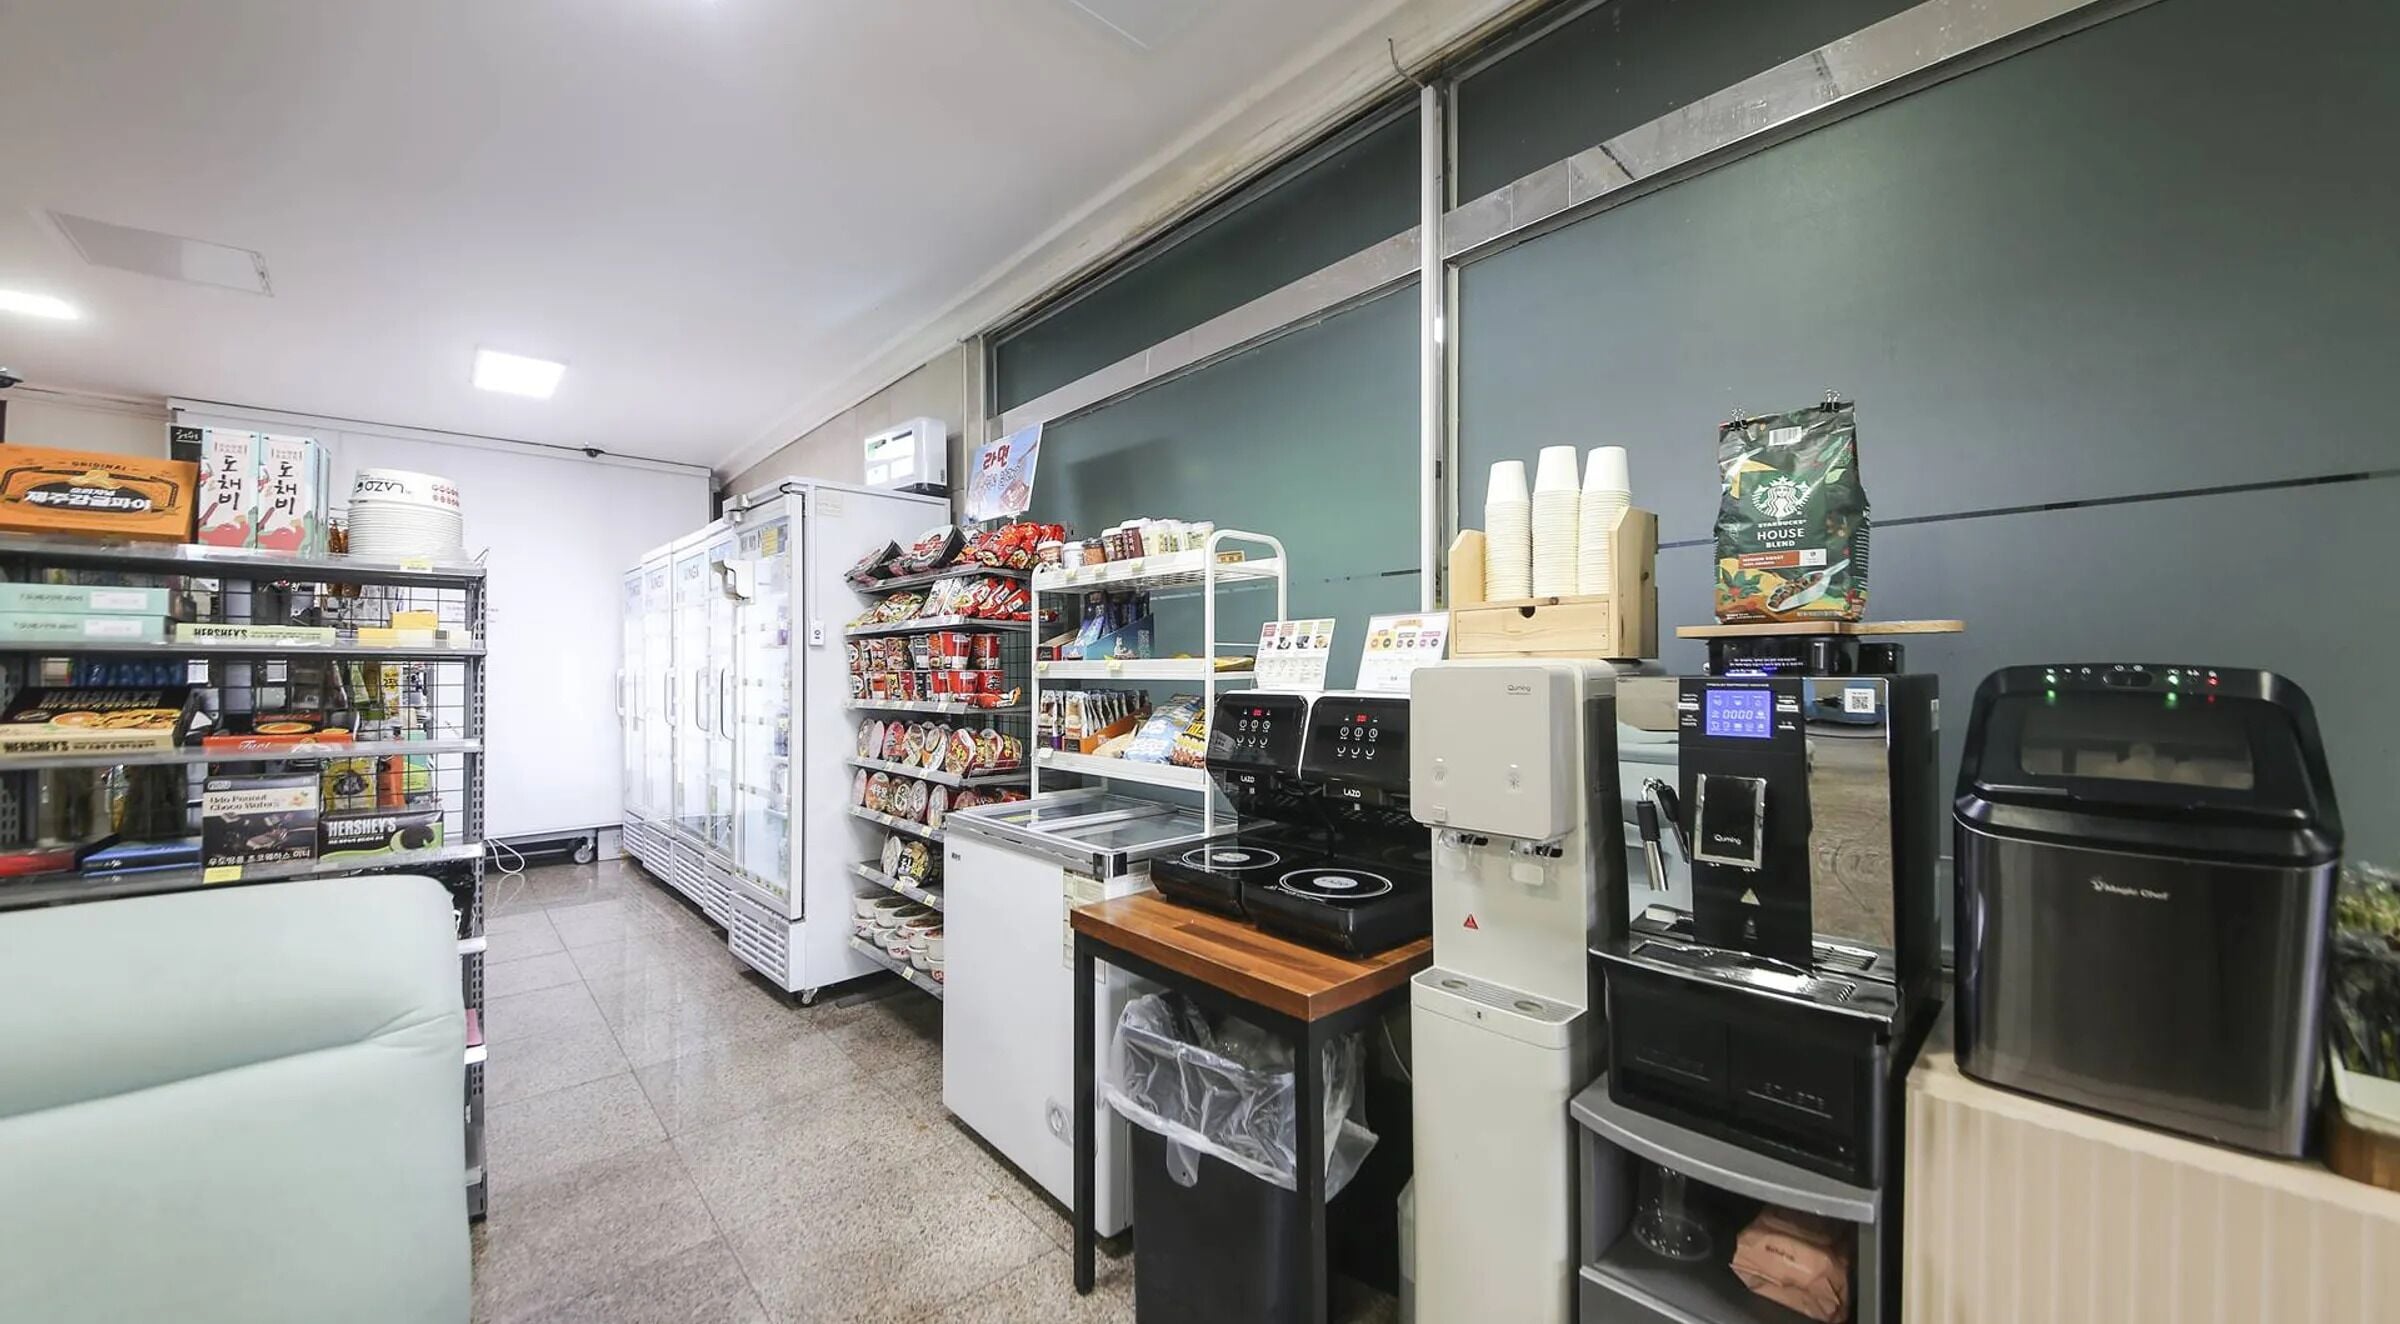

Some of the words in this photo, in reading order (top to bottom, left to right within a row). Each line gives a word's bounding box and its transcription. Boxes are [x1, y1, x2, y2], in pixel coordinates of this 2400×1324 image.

[71, 460, 127, 472] ORIGINAL
[982, 444, 1010, 470] 라면
[217, 455, 242, 511] 도채비
[273, 461, 297, 516] 도채비
[1757, 528, 1806, 541] HOUSE
[1766, 540, 1796, 548] BLEND
[327, 816, 397, 837] HERSHEY'S
